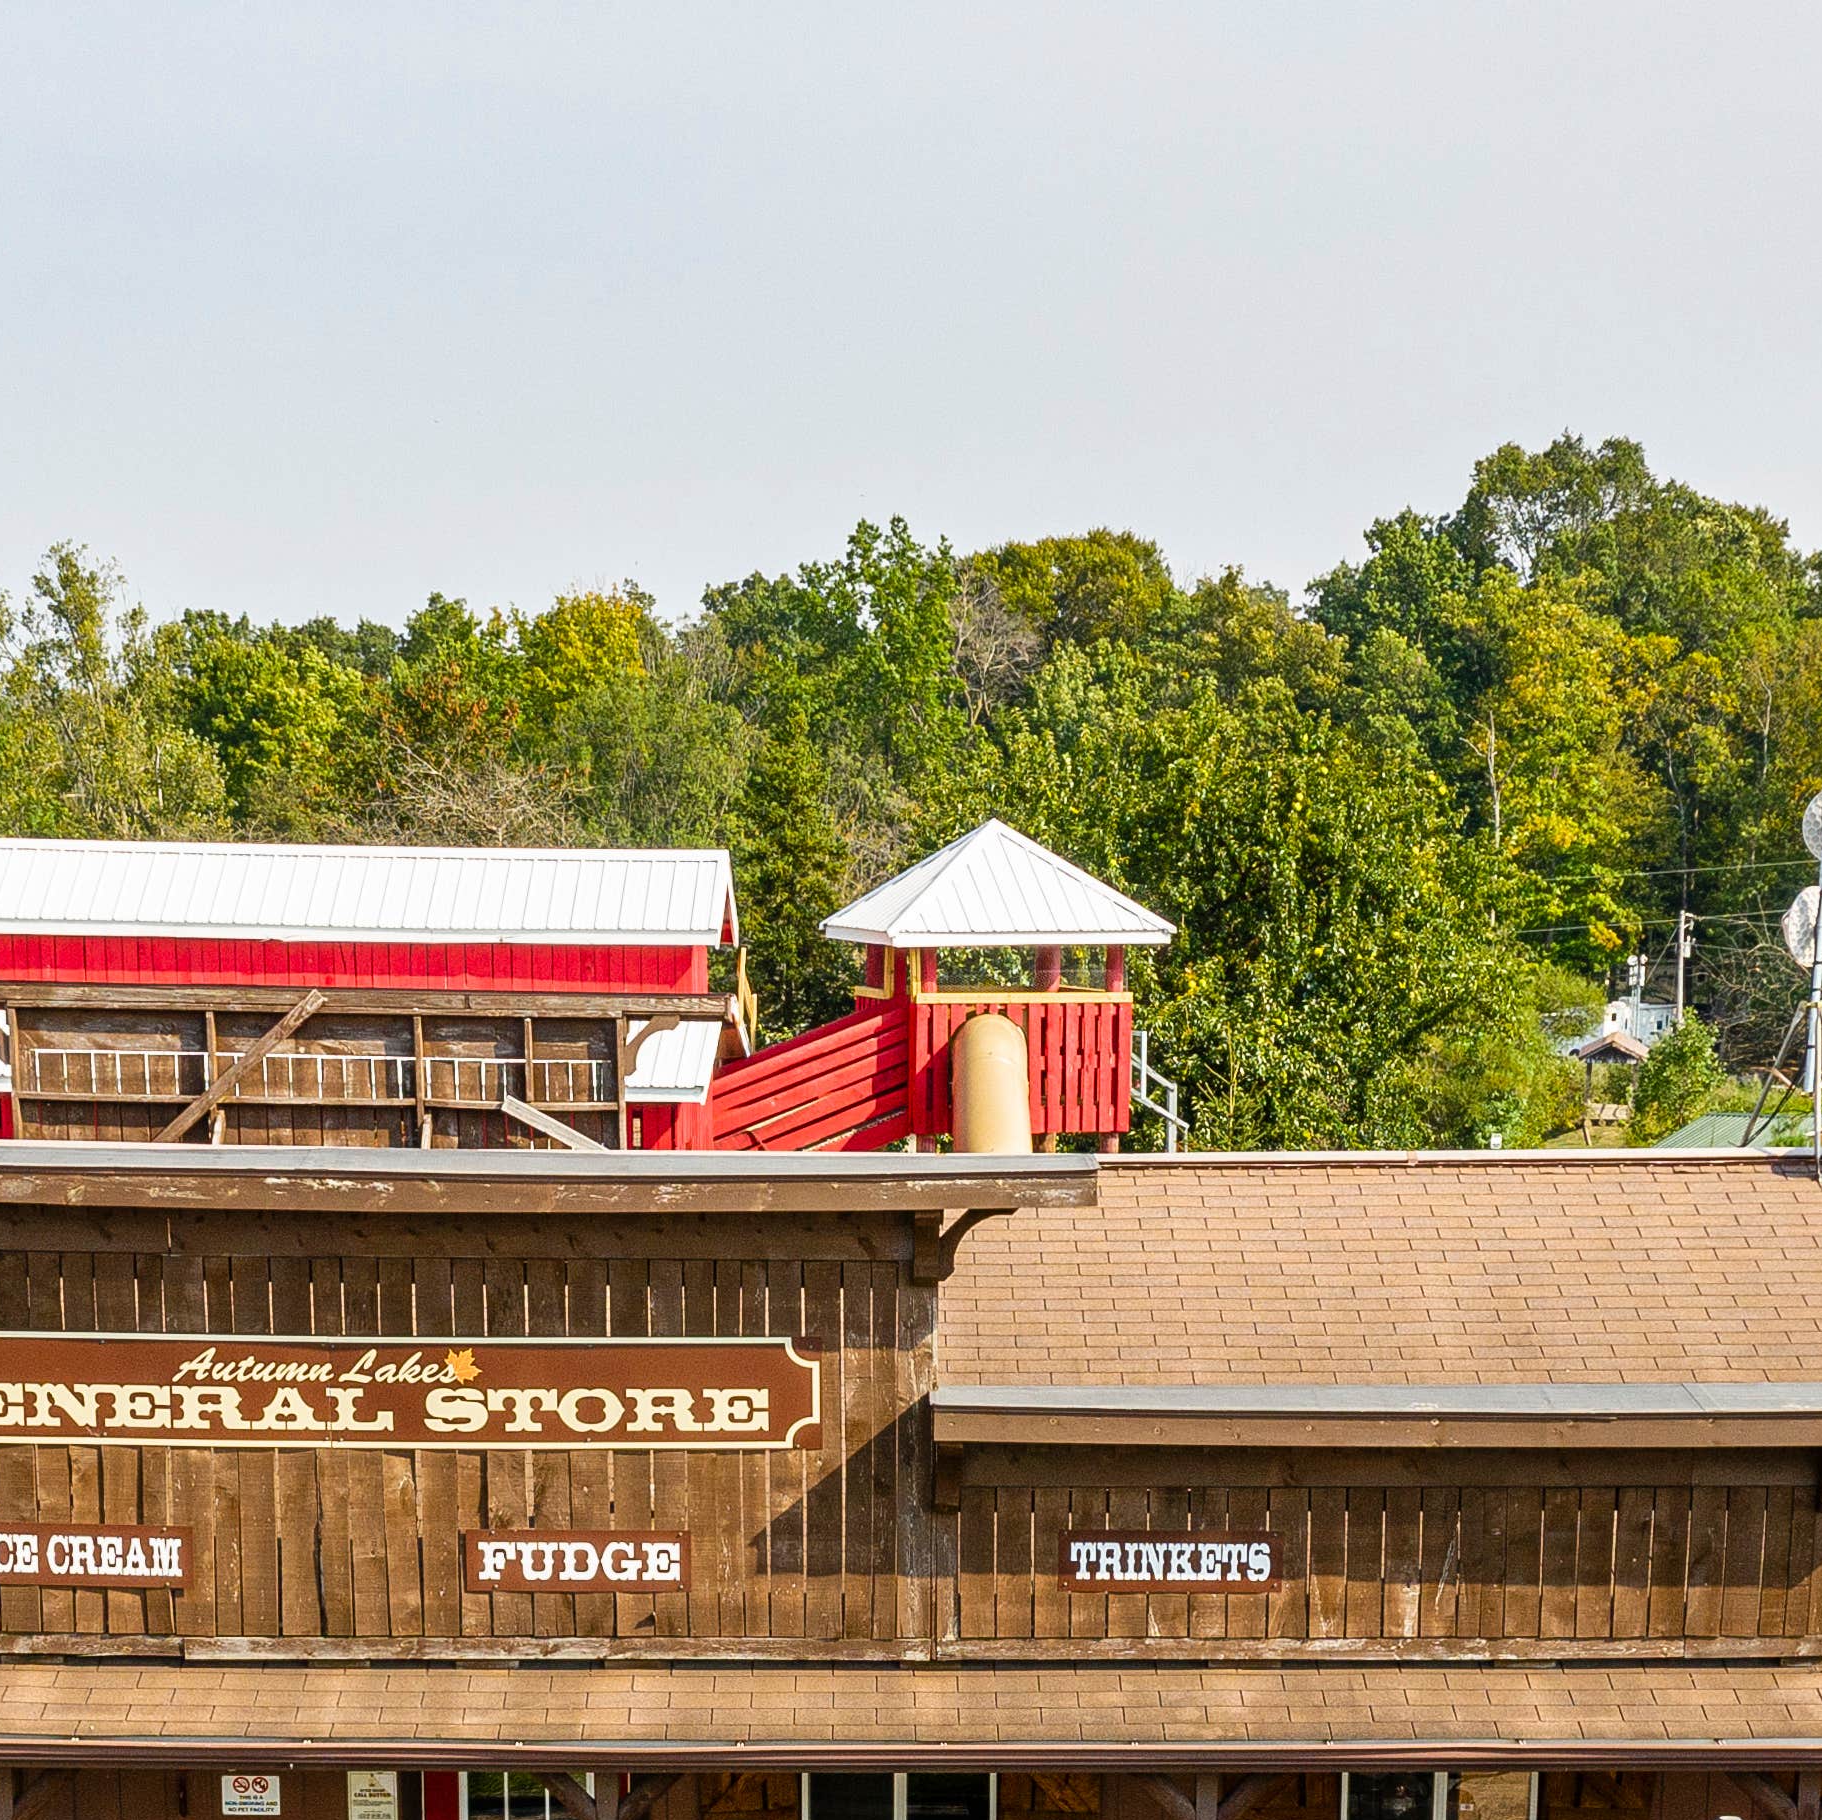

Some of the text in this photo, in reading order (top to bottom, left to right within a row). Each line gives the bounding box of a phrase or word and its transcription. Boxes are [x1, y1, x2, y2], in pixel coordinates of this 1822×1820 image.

[172, 1346, 459, 1385] Autumn Lakes
[424, 1386, 770, 1434] STORE
[45, 1534, 183, 1579] CREAM
[476, 1541, 682, 1583] FUDGE
[1070, 1541, 1271, 1582] TRINKETS
